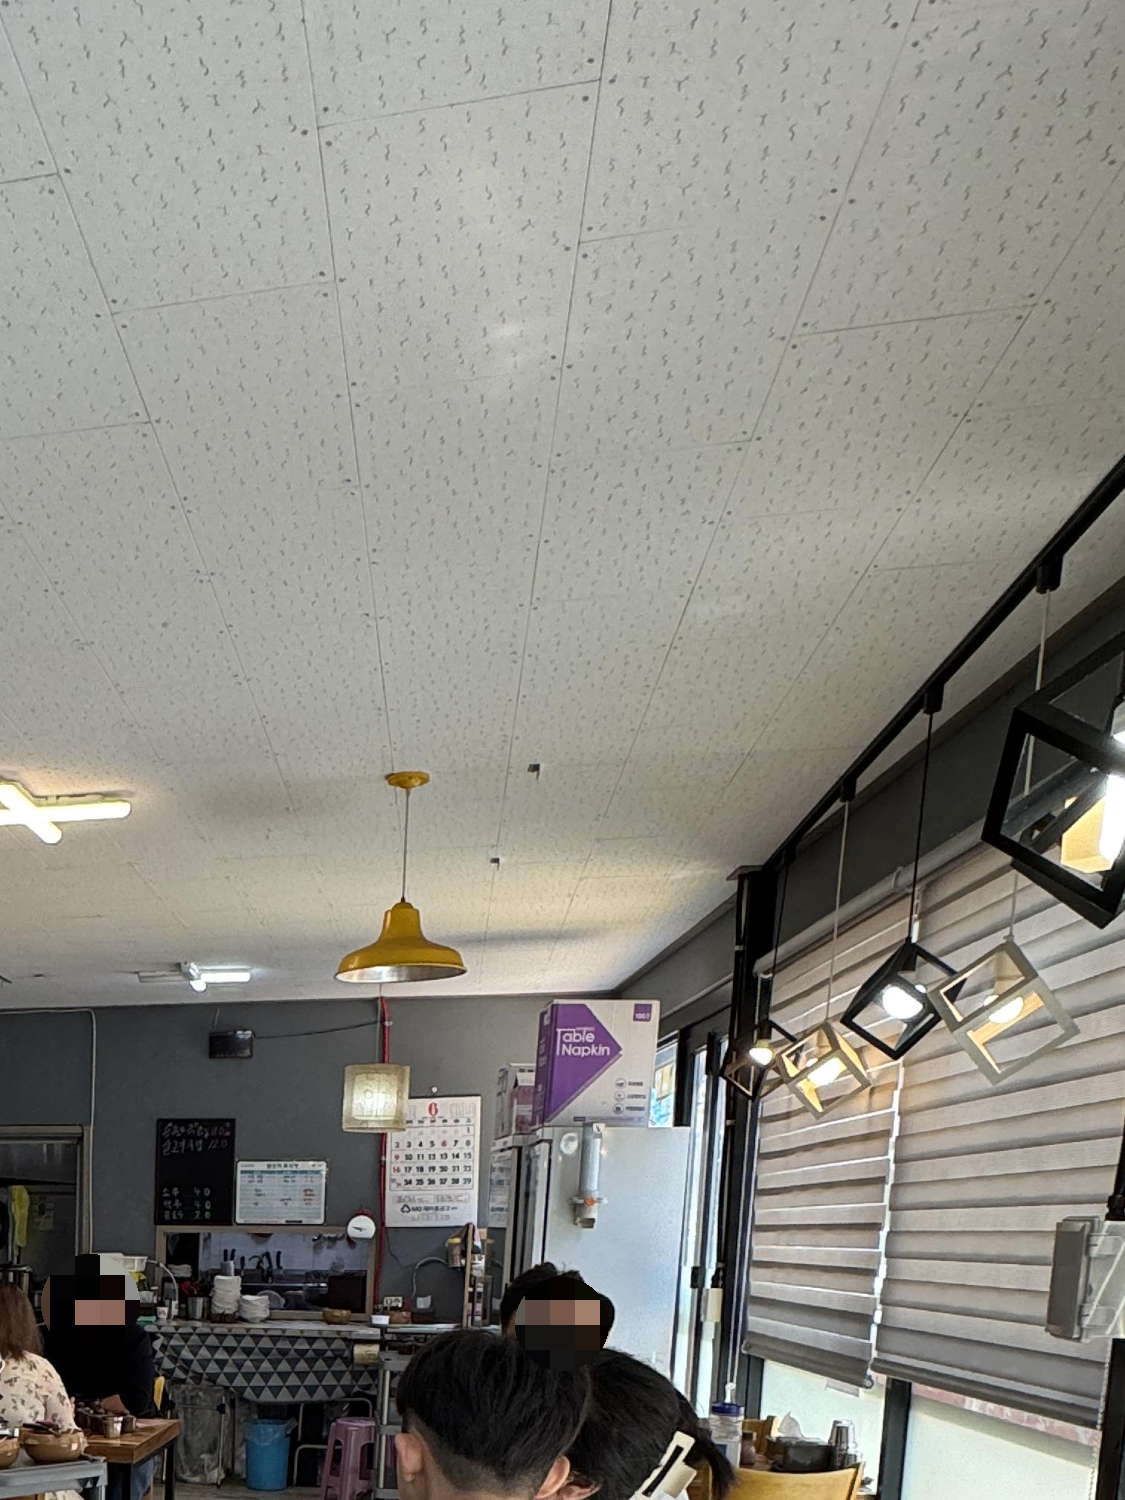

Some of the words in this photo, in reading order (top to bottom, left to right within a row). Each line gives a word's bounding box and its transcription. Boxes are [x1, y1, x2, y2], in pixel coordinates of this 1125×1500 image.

[556, 1028, 595, 1056] Table
[561, 1043, 610, 1058] Napkin
[428, 1102, 438, 1115] 6
